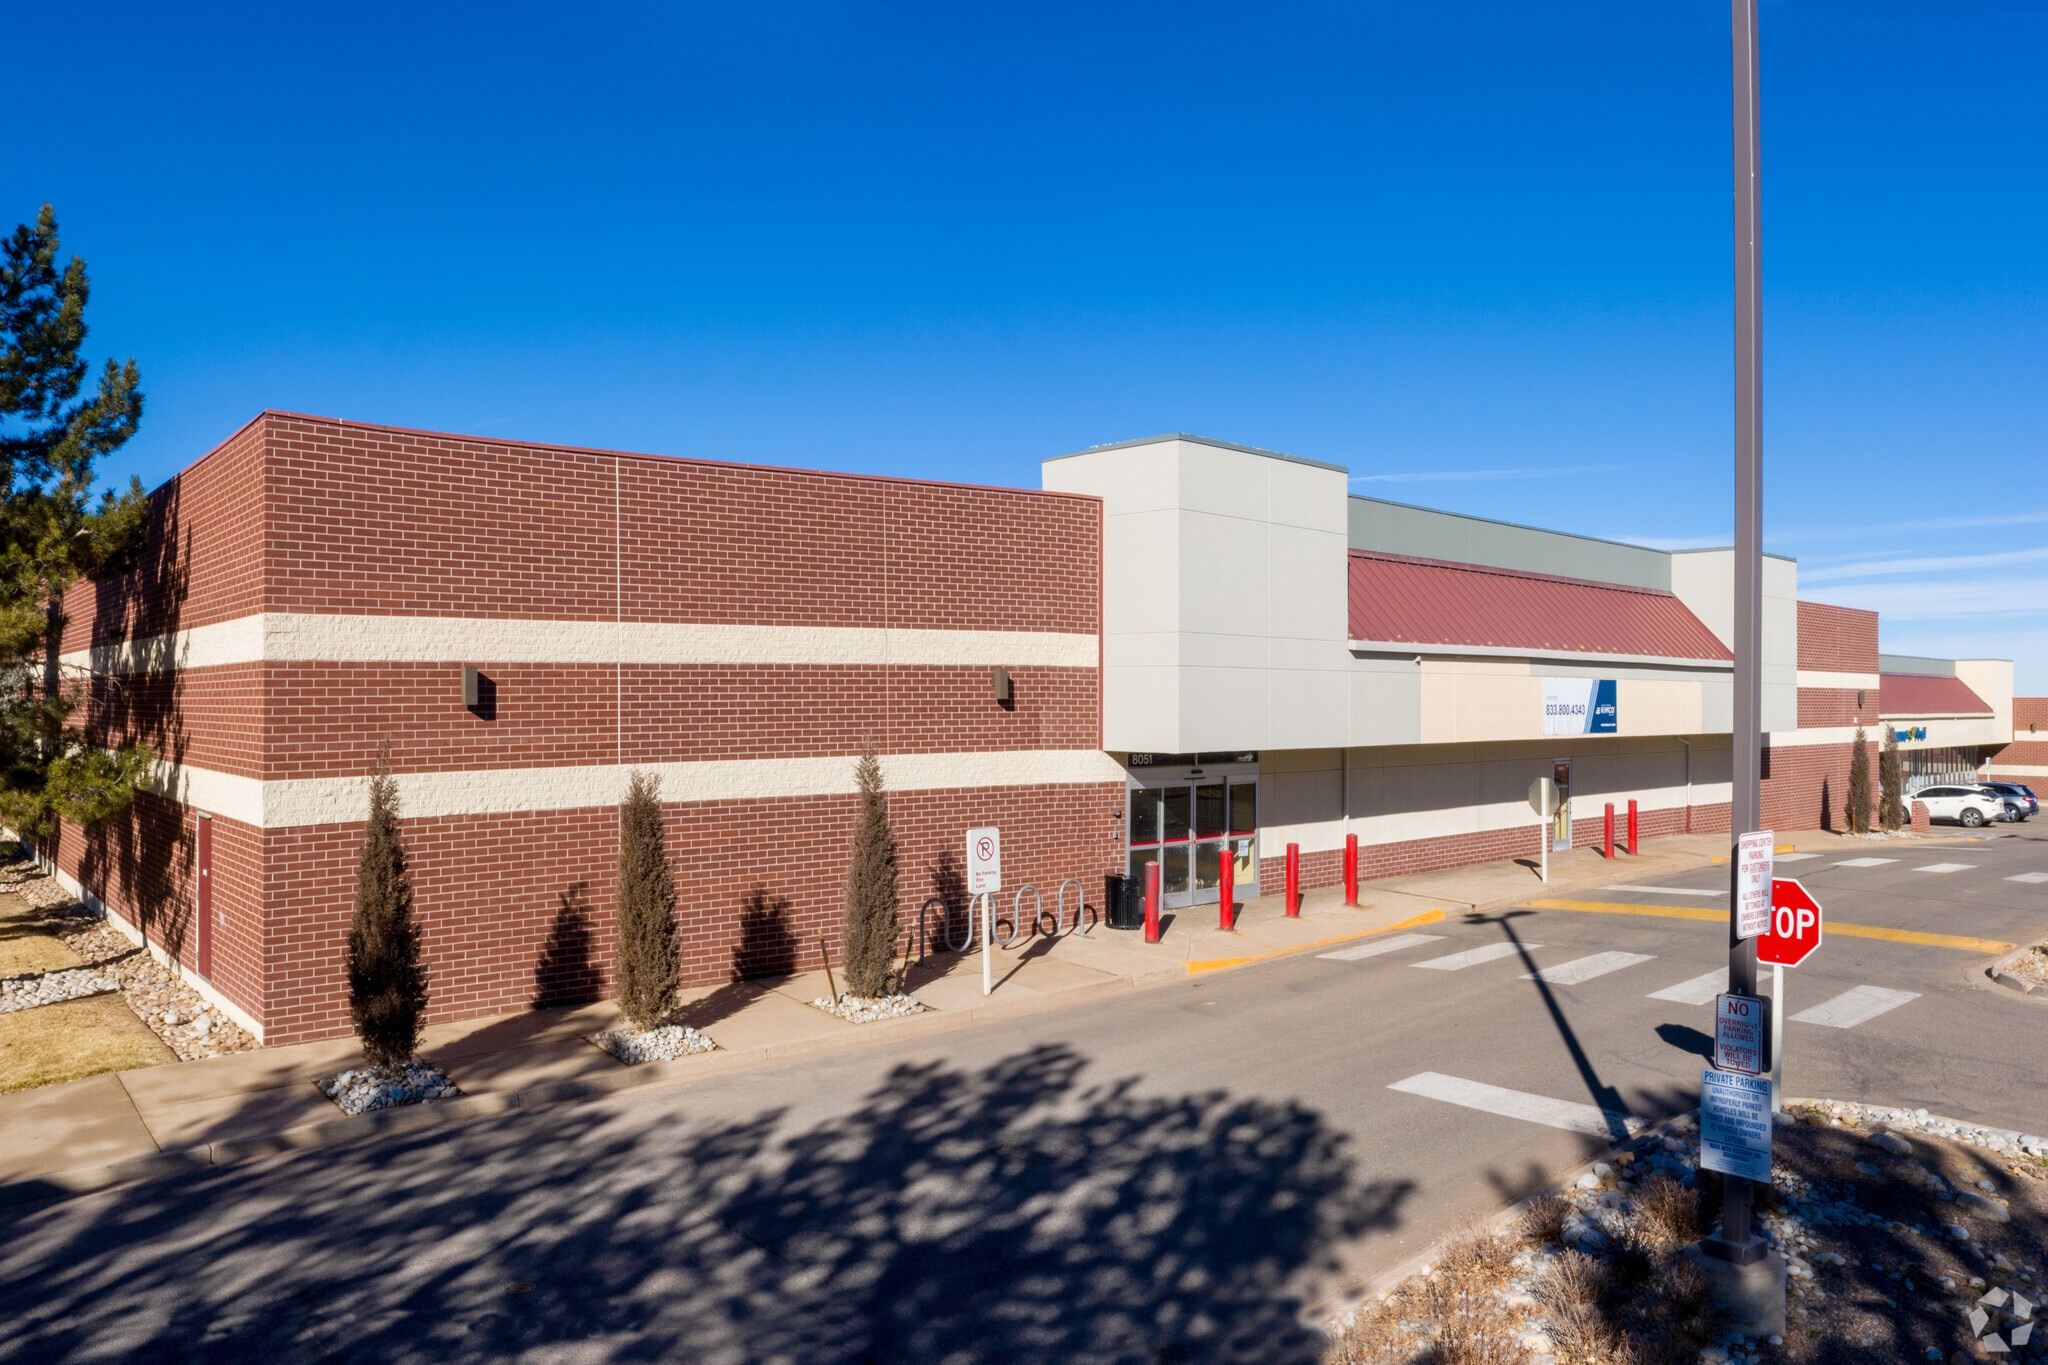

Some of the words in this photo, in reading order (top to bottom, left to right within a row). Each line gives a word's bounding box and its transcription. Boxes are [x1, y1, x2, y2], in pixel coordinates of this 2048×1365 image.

[1546, 704, 1585, 716] 833.800.4343
[1132, 754, 1152, 765] 8051
[1740, 838, 1758, 850] SHOPPING
[1759, 837, 1772, 846] CENTER
[1748, 850, 1764, 860] PARKING
[1750, 860, 1770, 872] CUSTOMERS
[1751, 874, 1760, 884] ONLY
[1749, 890, 1761, 900] OTHERS
[1745, 902, 1749, 910] BE
[1750, 900, 1760, 910] TOWED
[1741, 912, 1754, 922] OWNERS
[1754, 909, 1768, 919] EXPENSE
[1742, 922, 1756, 931] WITHOUT
[1756, 920, 1768, 928] NOTICE
[1728, 1002, 1749, 1016] NO
[1724, 1024, 1754, 1035] PARKING
[1722, 1031, 1754, 1042] ALLOWED
[1720, 1043, 1757, 1056] VIOLATORS
[1724, 1052, 1741, 1060] WILL
[1743, 1054, 1752, 1062] BE
[1726, 1058, 1750, 1068] TOWED
[1704, 1071, 1733, 1085] PRIVATE
[1736, 1077, 1767, 1092] PARKING
[1712, 1087, 1750, 1099] UNAUTHORIZED
[1710, 1095, 1740, 1107] IMPROPERLY
[1742, 1101, 1762, 1112] PARKED
[1713, 1105, 1736, 1116] VEHICLES
[1738, 1110, 1750, 1119] WILL
[1725, 1116, 1734, 1125] AND
[1736, 1119, 1766, 1131] IMPOUNDED
[1718, 1124, 1738, 1134] VEHICLE
[1739, 1129, 1761, 1140] OWNERS
